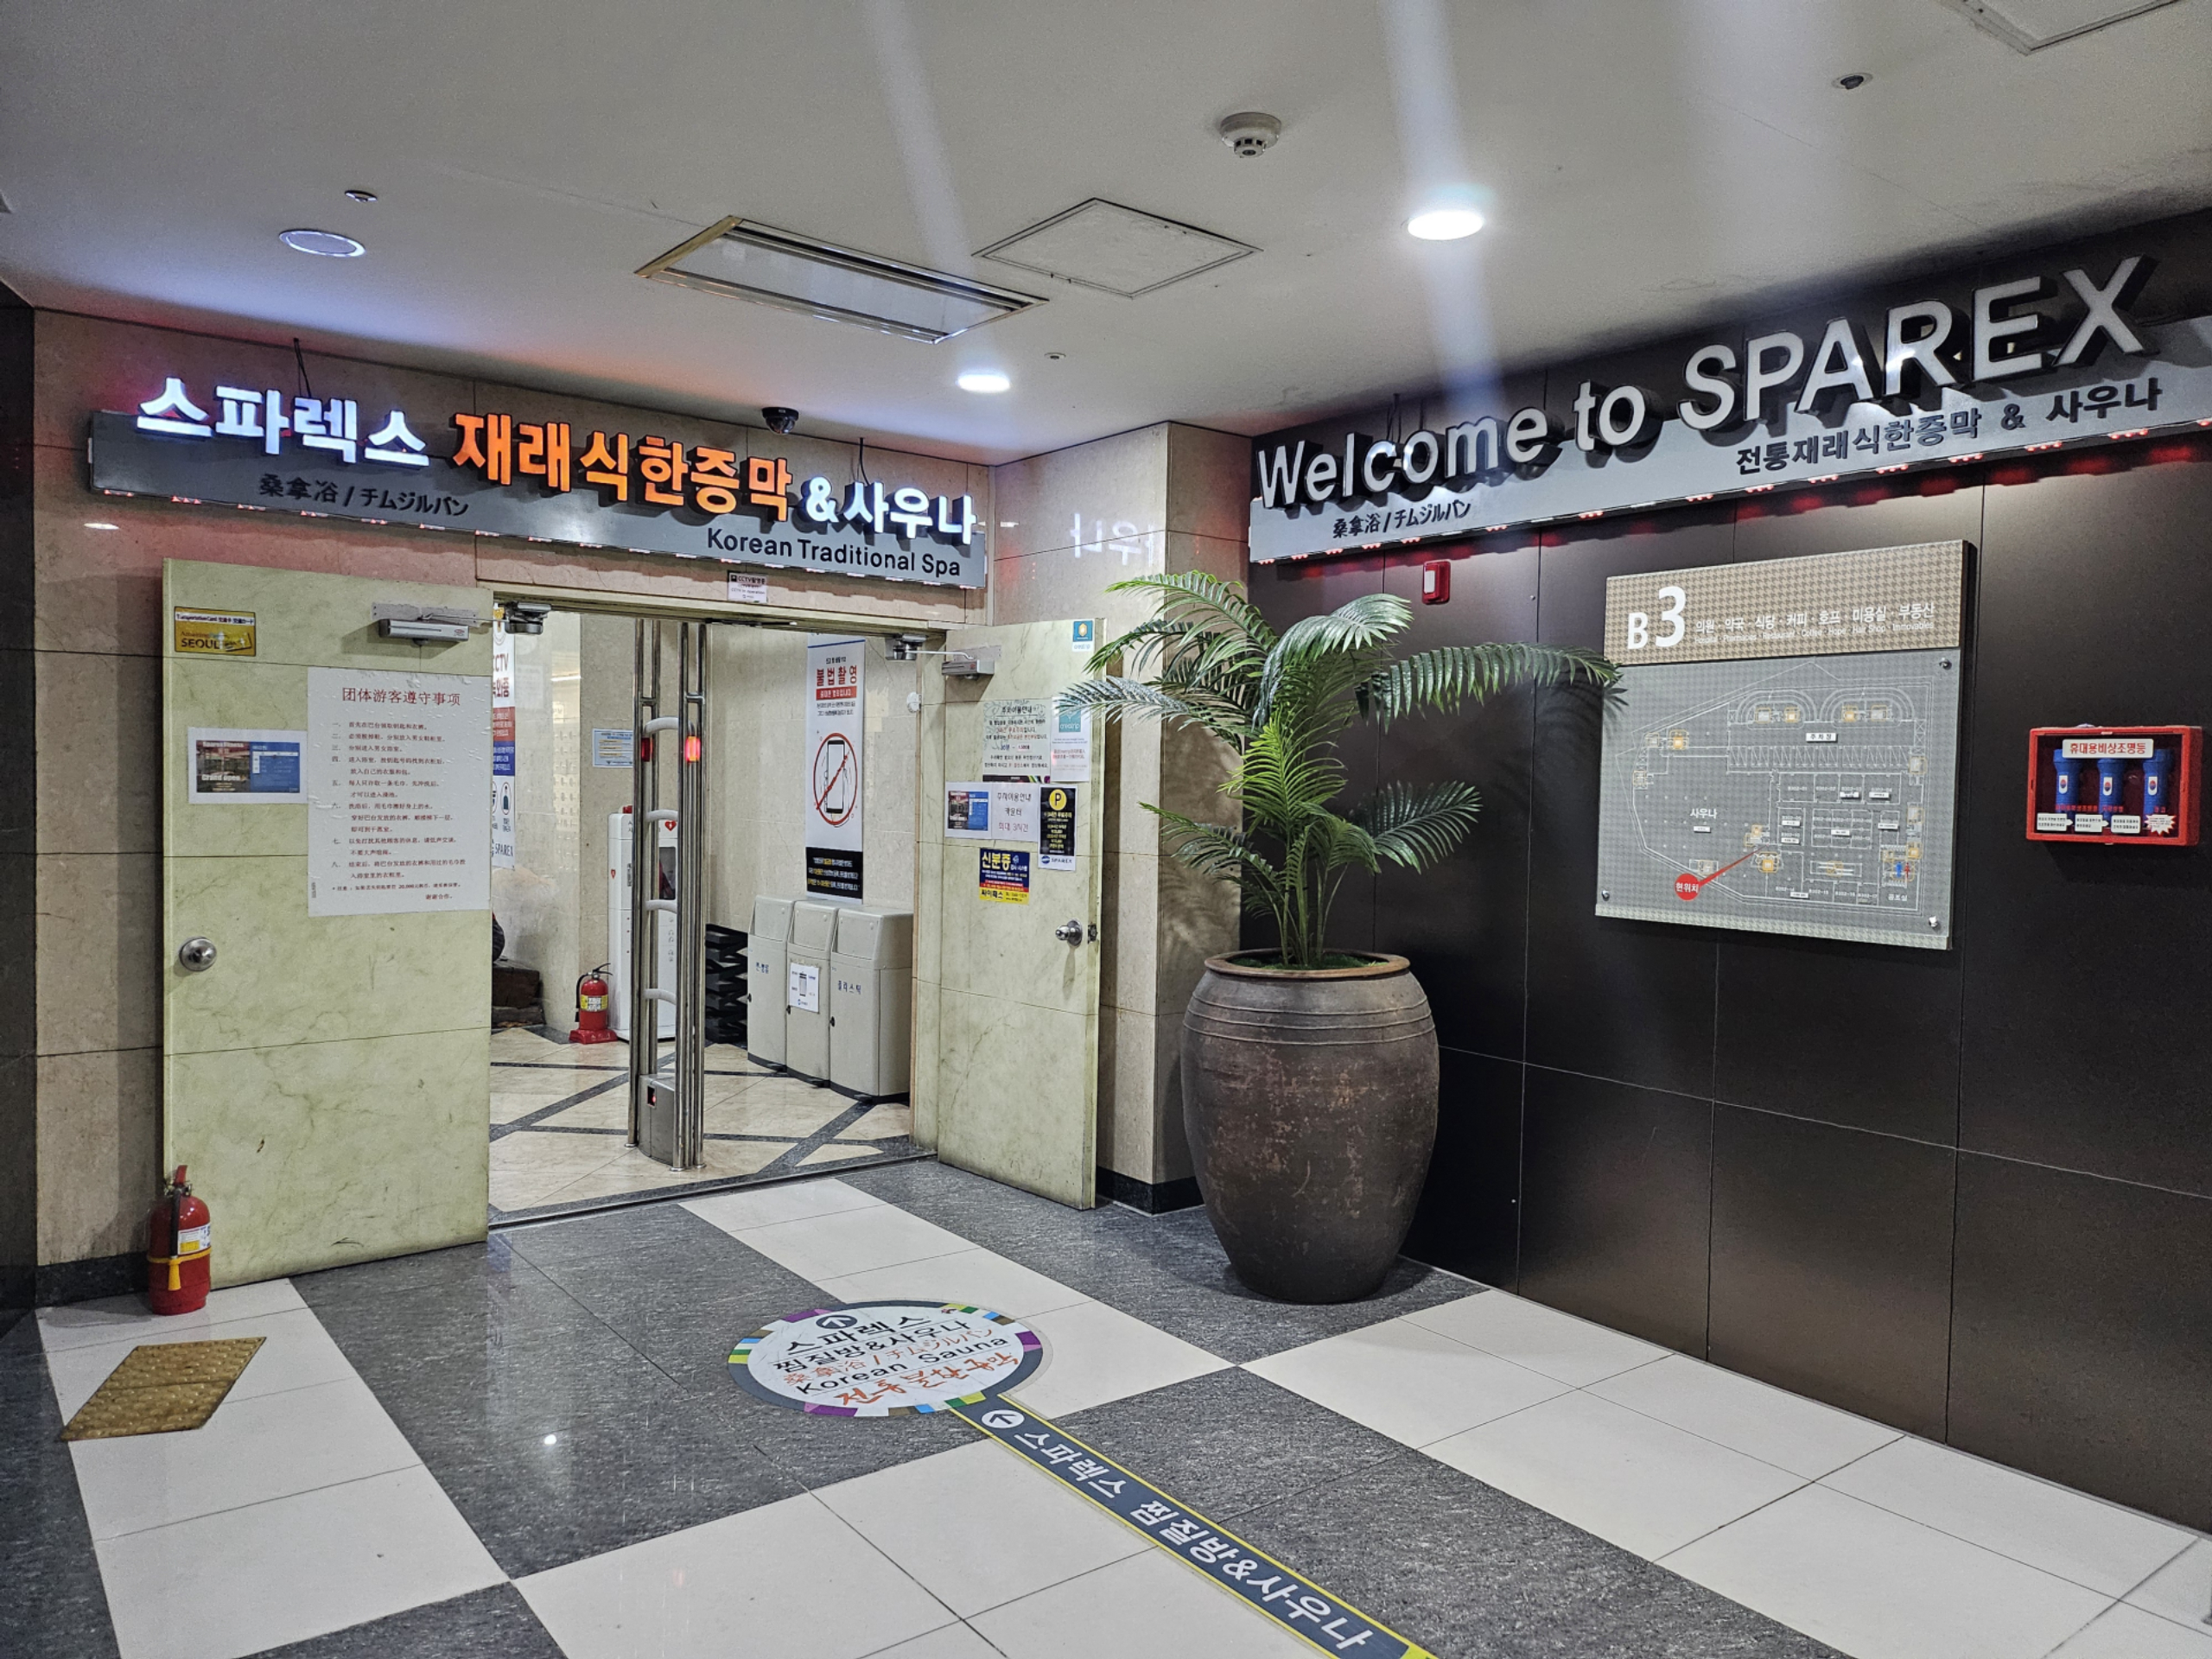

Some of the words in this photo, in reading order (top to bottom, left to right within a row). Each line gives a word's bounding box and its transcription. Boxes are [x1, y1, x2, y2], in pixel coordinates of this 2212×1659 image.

[1256, 406, 1548, 510] Welcome
[1573, 380, 1647, 451] to
[1679, 256, 2145, 429] SPAREX
[137, 377, 429, 467] 스파렉스
[2001, 400, 2025, 430] &
[2046, 378, 2164, 423] 사우나
[707, 527, 792, 558] Korean
[798, 538, 915, 572] Traditional
[921, 554, 961, 577] Spa
[1627, 612, 1649, 650] B
[1655, 586, 1687, 648] 3
[1695, 620, 1714, 634] 의원
[1724, 617, 1744, 632] 약국
[1754, 614, 1776, 630] 식당
[1786, 613, 1808, 628] 커피
[1817, 610, 1840, 625] 호프
[1852, 606, 1887, 623] 미용실
[1898, 602, 1935, 620] 부동산
[1828, 627, 1847, 636] Hope
[1868, 625, 1885, 634] Shop
[181, 639, 220, 650] SEOUL
[342, 687, 461, 707] 团体游客遵守事项
[2069, 742, 2146, 754] 휴대용비상조명등
[1054, 792, 1062, 806] P
[1689, 808, 1718, 819] 사우나
[982, 851, 1011, 871] 신분증
[1675, 882, 1700, 893] 현위치
[788, 1315, 931, 1356] 스파렉스
[796, 1363, 907, 1395] Korean
[918, 1337, 1009, 1364] Sauna
[1014, 1432, 1124, 1499] 스파렉스
[1130, 1500, 1375, 1649] 찜질방&사우나
